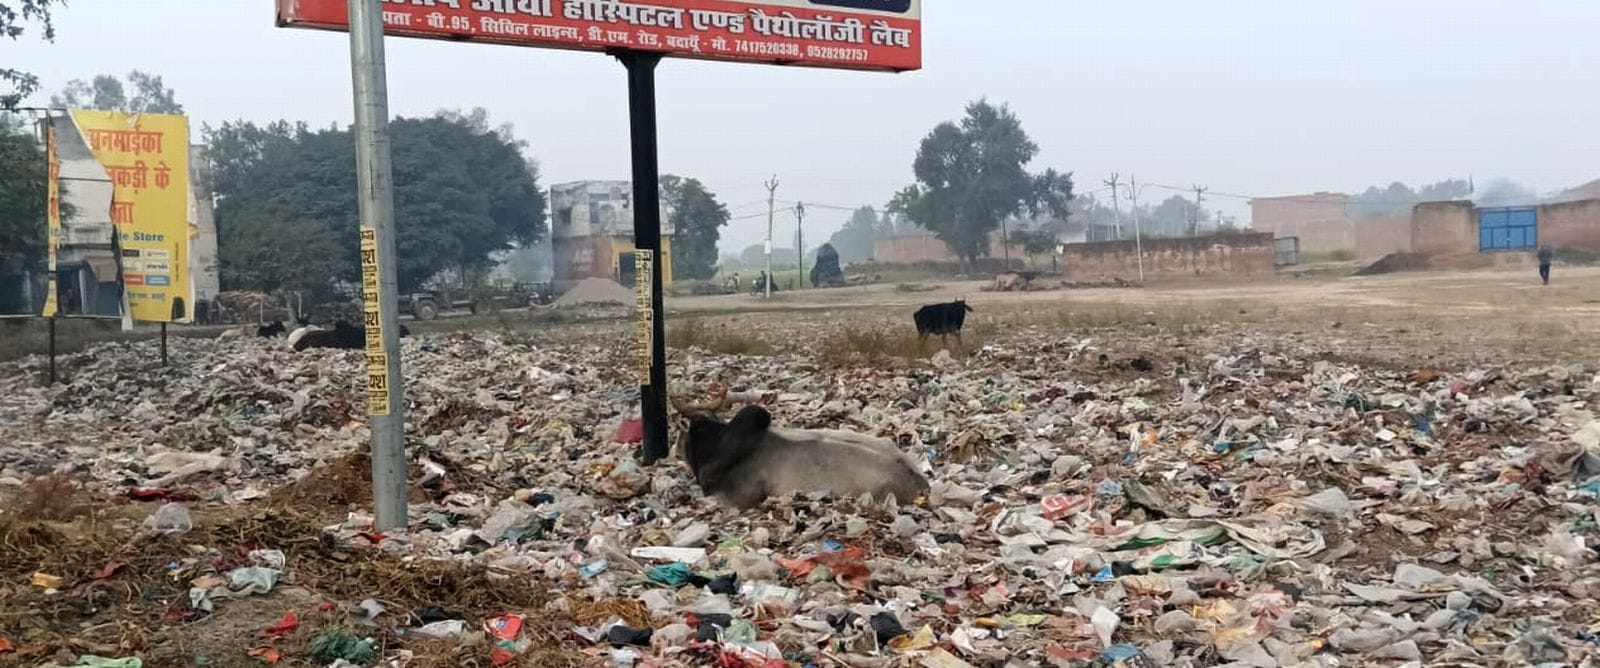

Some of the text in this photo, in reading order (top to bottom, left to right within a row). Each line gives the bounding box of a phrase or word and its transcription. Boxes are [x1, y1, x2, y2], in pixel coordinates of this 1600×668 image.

[382, 11, 411, 25] पता
[480, 16, 528, 35] सिविल
[688, 9, 747, 33] एण्ड
[869, 20, 912, 47] लैब
[153, 161, 171, 190] के
[133, 231, 164, 242] Store
